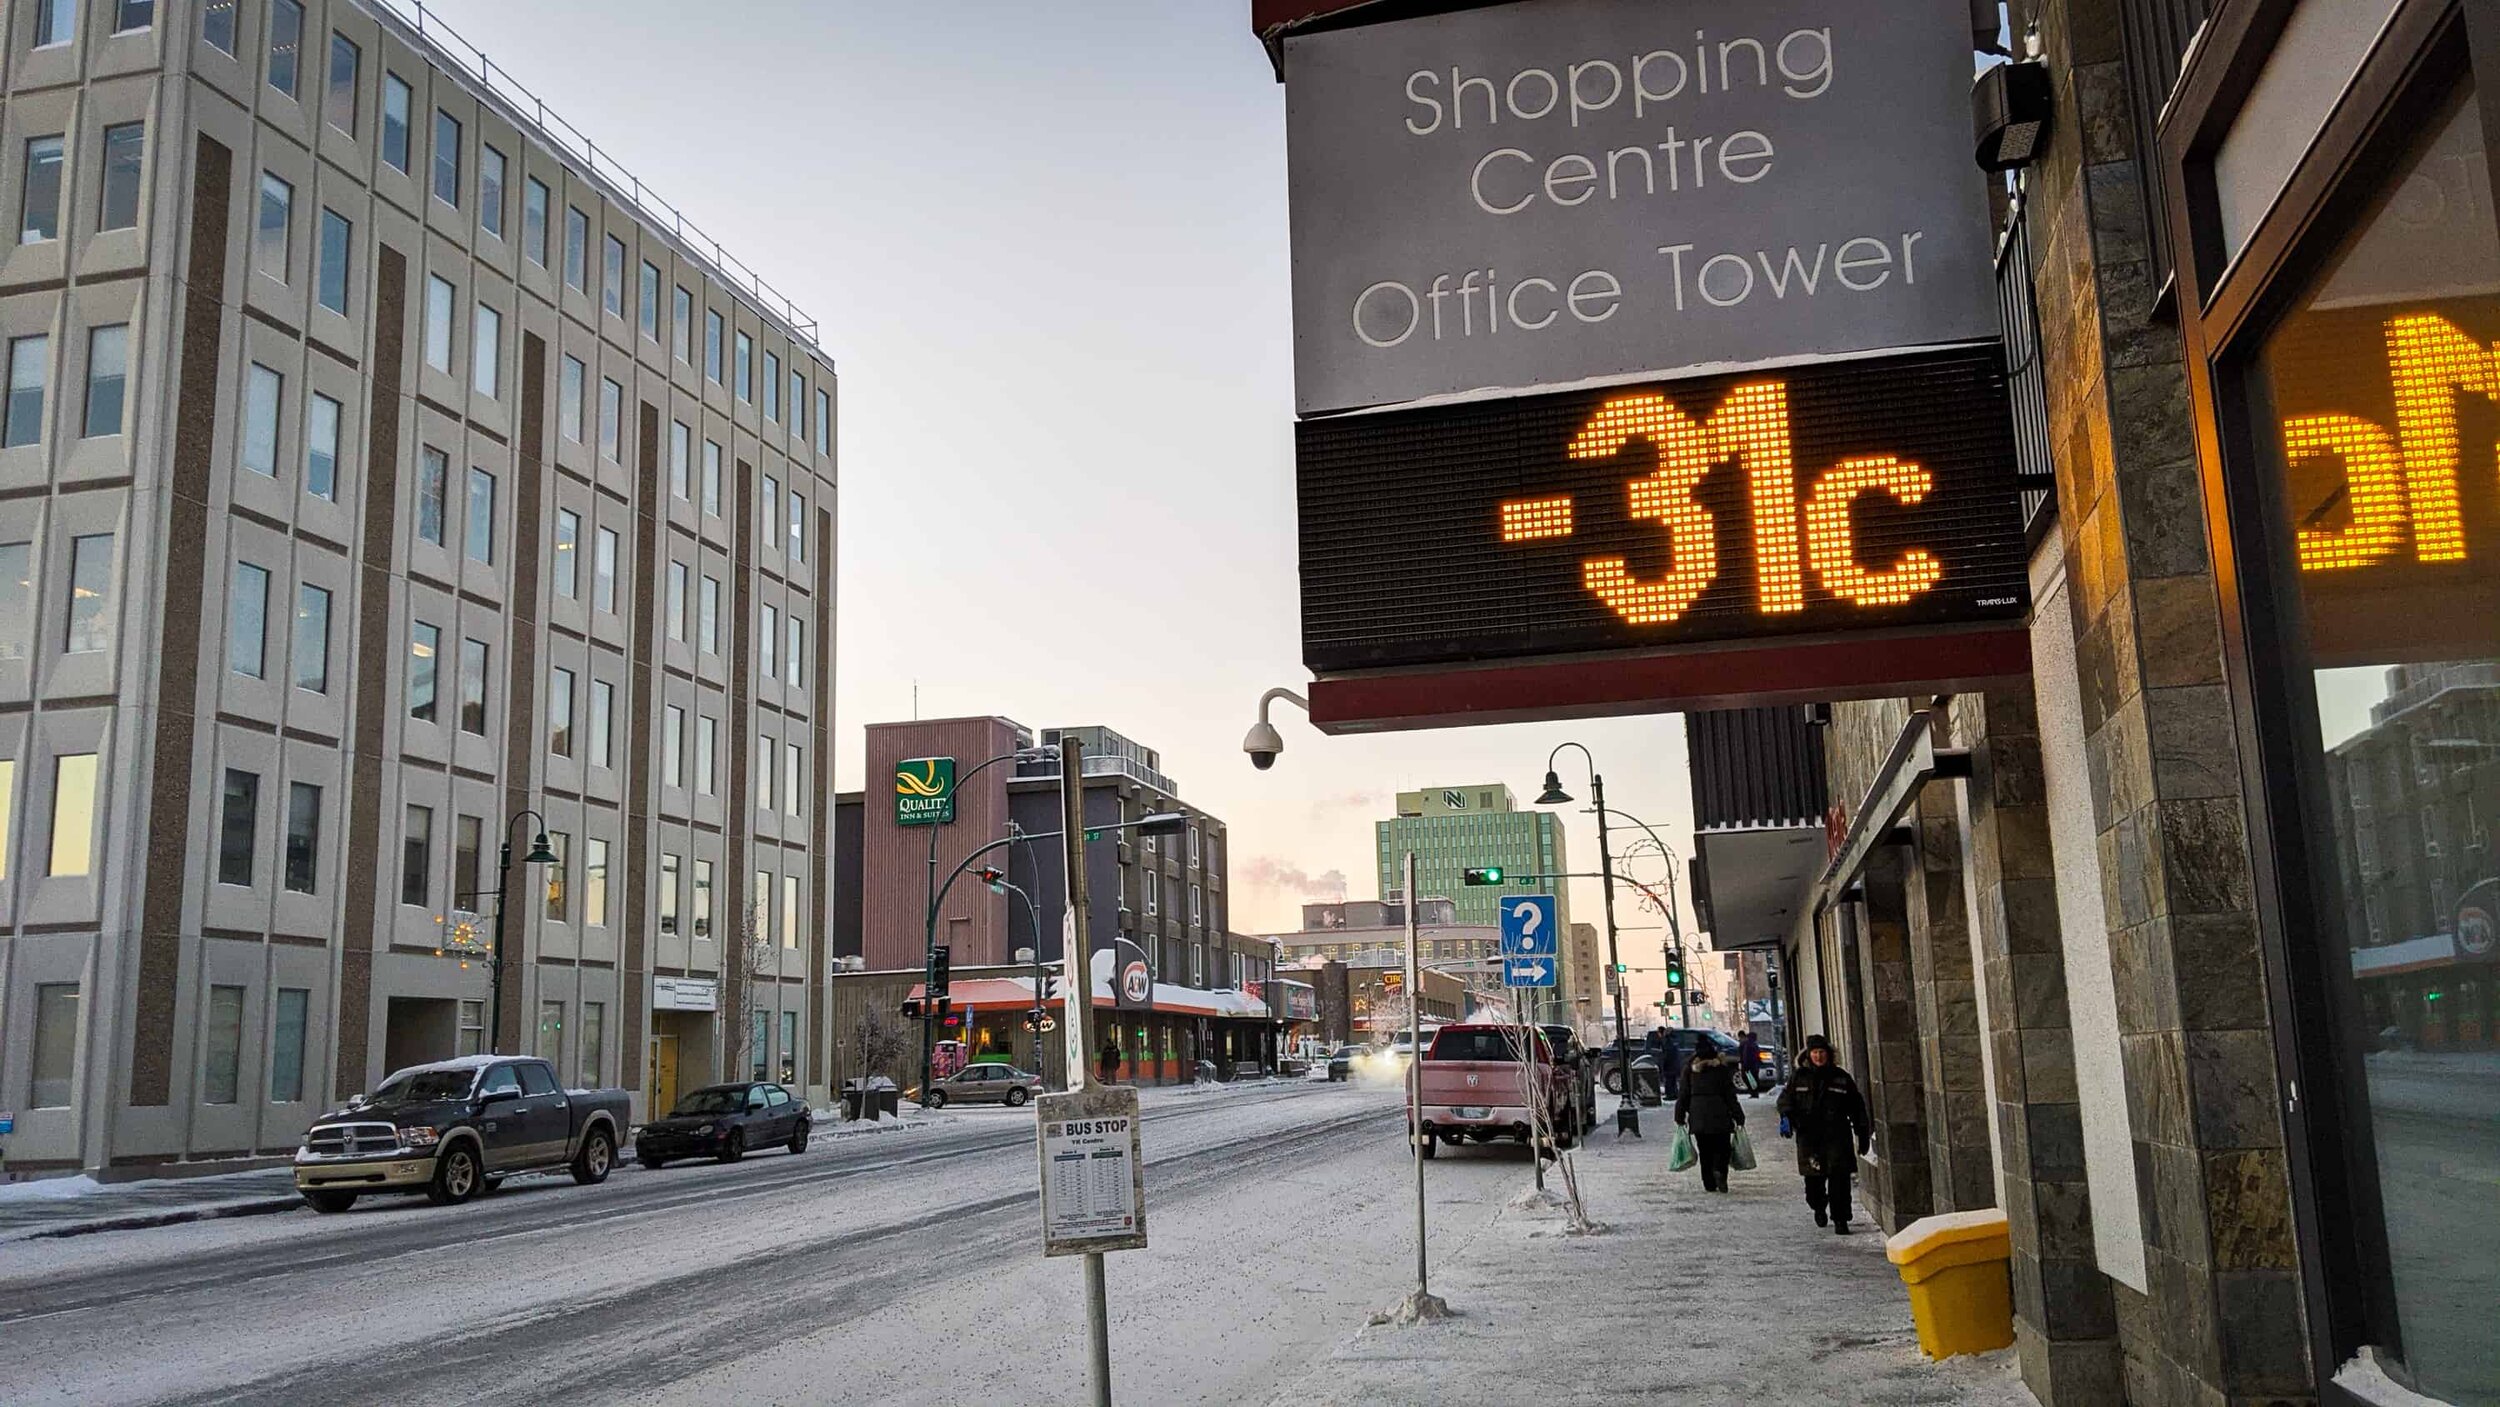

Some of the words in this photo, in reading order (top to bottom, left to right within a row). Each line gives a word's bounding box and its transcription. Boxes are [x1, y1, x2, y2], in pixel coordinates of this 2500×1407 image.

[1404, 26, 1834, 136] Shopping
[1470, 126, 1774, 215] Centre
[1351, 267, 1623, 349] Office
[1657, 230, 1924, 312] Tower
[899, 797, 949, 814] QUALIT
[1066, 1122, 1091, 1136] BUS
[1095, 1119, 1127, 1134] STOP
